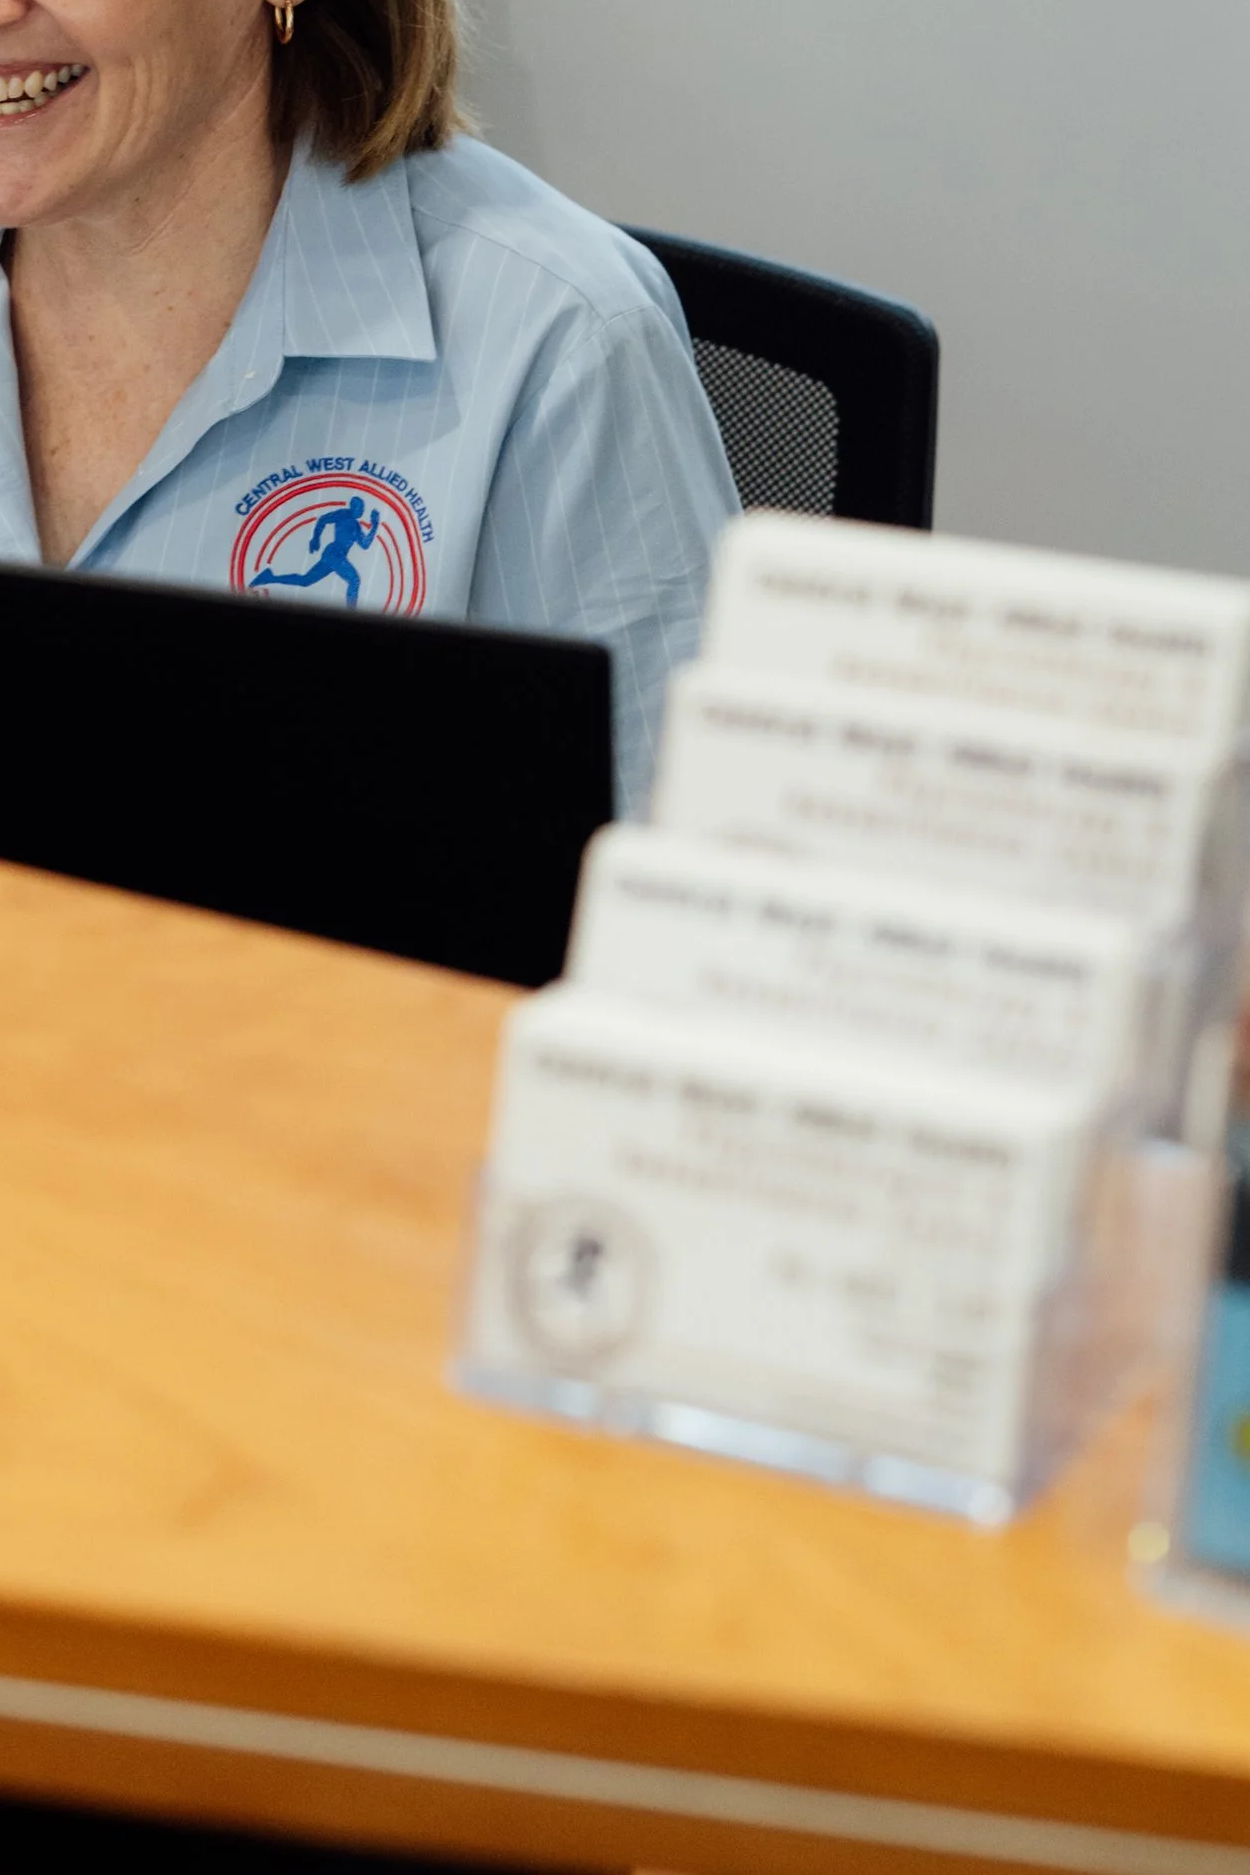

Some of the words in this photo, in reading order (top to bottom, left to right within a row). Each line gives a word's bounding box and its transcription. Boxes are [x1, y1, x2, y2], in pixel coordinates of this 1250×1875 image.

[235, 465, 303, 516] CENTRAL
[306, 457, 355, 472] WEST
[358, 459, 408, 492] ALLIED
[404, 488, 434, 543] HEALTH
